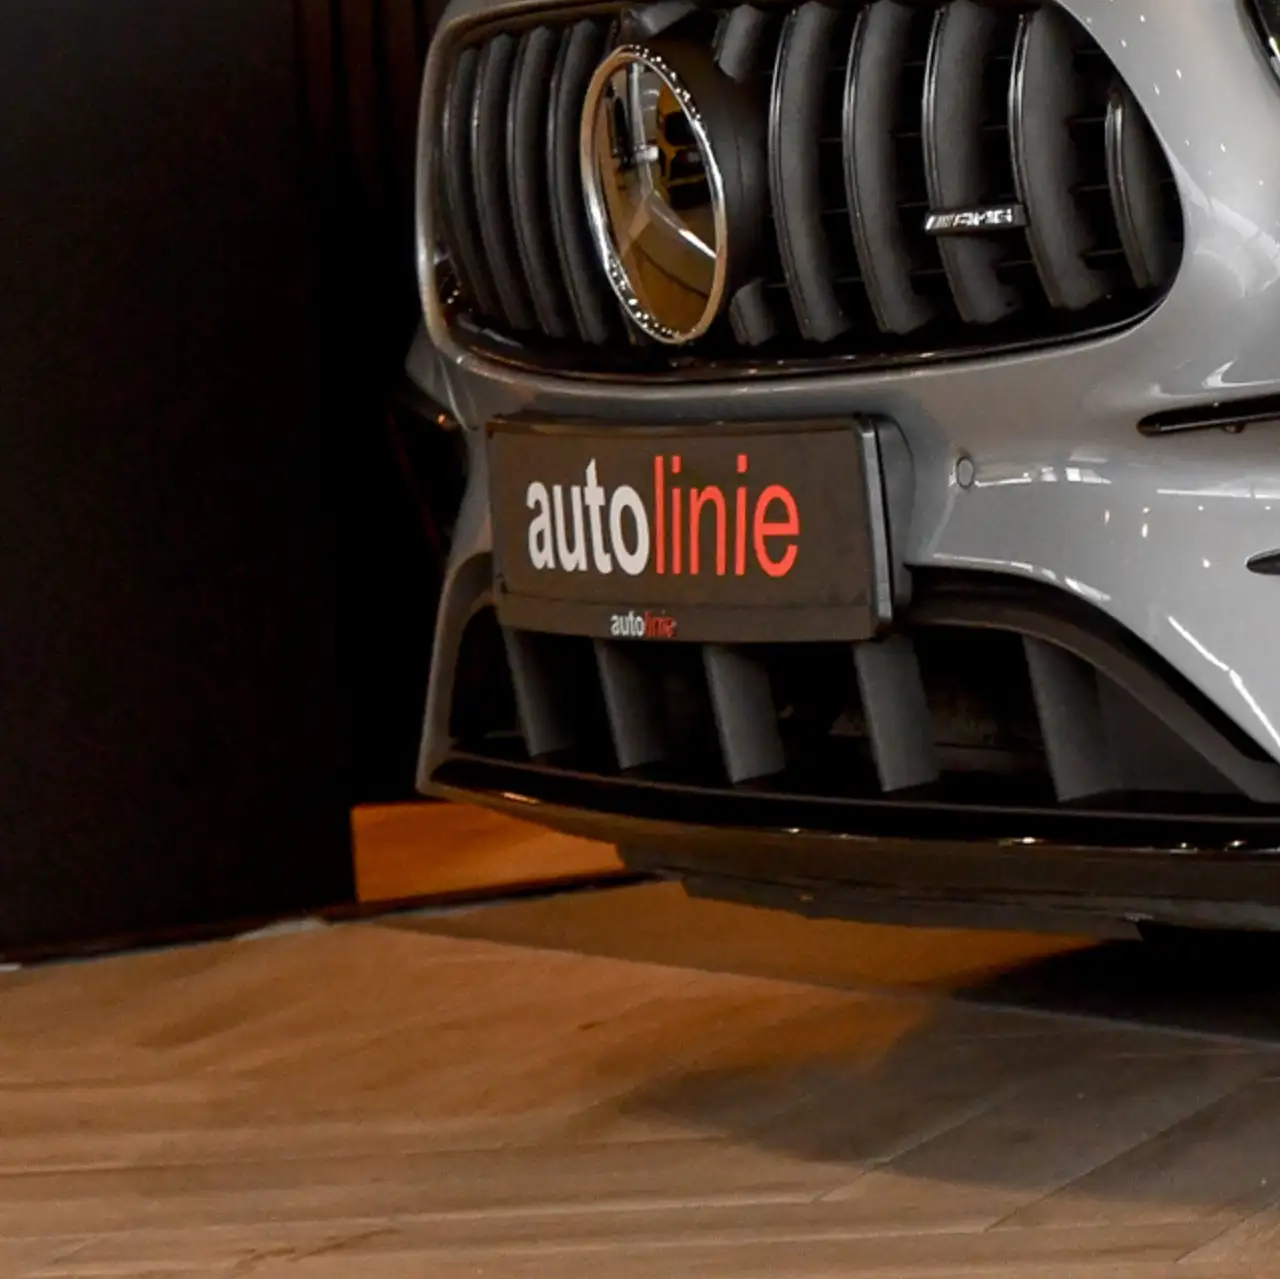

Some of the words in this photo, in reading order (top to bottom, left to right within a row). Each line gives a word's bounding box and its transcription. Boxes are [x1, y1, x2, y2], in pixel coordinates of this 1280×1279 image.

[952, 208, 1013, 228] AMG
[526, 454, 800, 578] autolinie
[610, 611, 677, 638] autolinie
